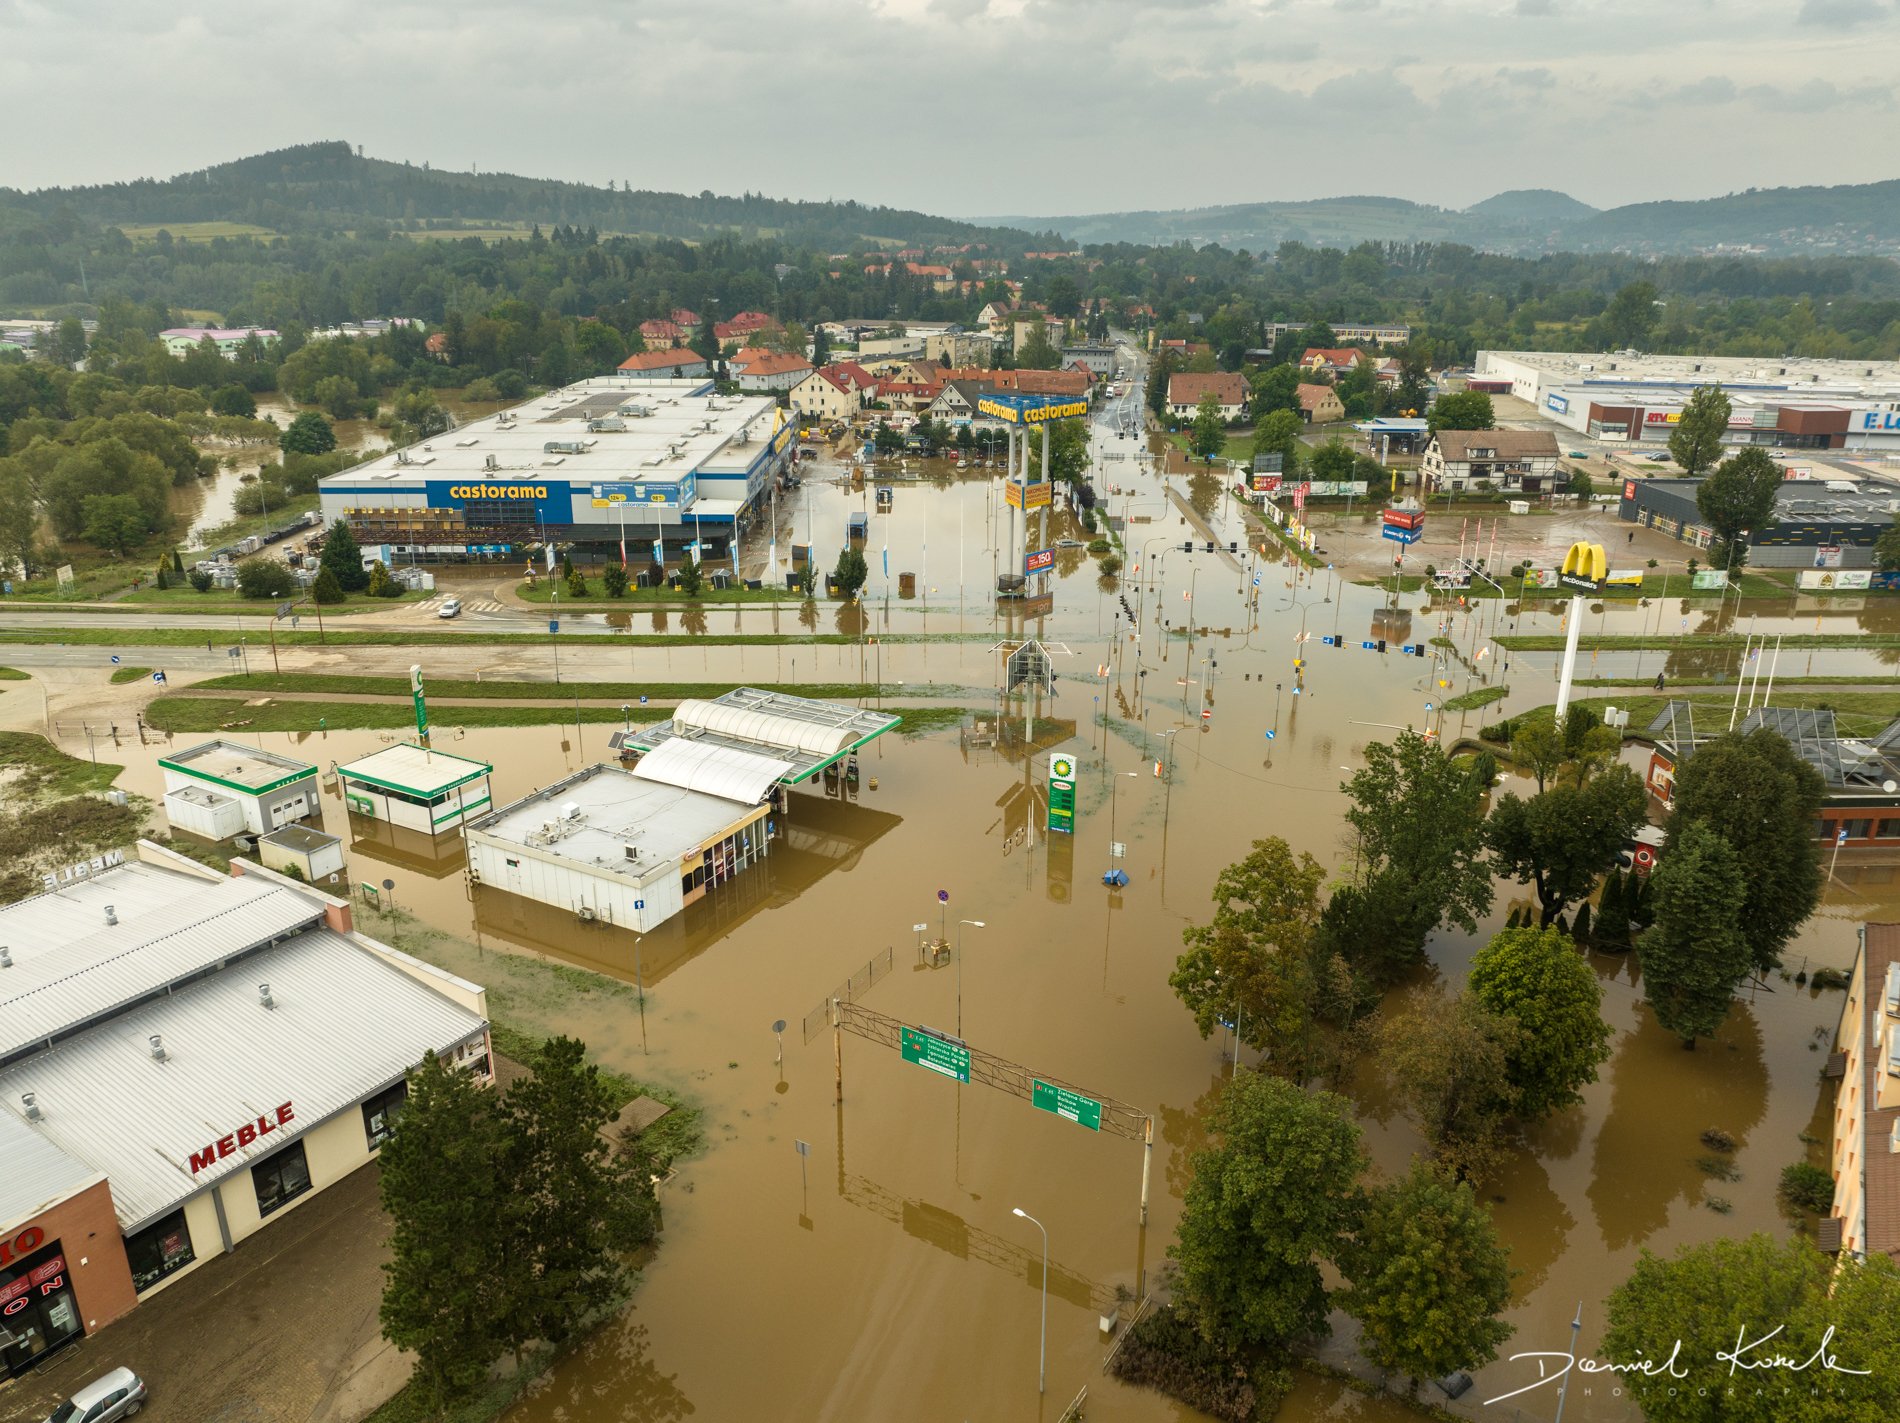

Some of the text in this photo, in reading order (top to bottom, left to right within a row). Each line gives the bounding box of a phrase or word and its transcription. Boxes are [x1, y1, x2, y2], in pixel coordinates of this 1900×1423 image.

[978, 400, 1018, 422] castorama
[1024, 402, 1087, 422] castorama
[1648, 413, 1667, 422] RTV
[449, 484, 547, 498] castorama
[1562, 576, 1598, 590] McDonald's
[189, 1100, 295, 1174] MEBLE
